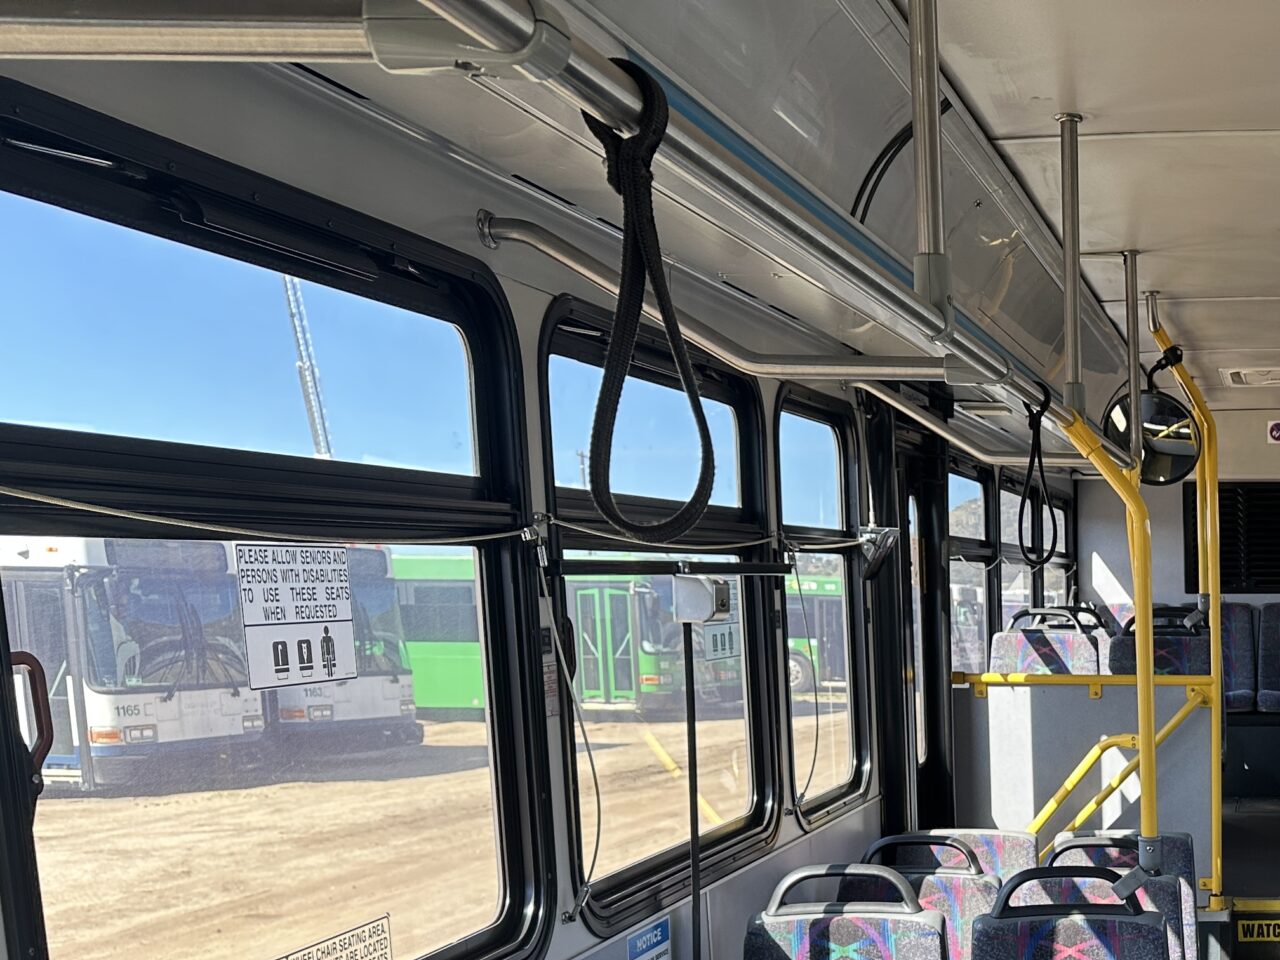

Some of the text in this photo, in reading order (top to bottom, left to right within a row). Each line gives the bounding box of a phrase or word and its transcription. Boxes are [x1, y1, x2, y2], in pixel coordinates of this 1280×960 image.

[239, 549, 346, 564] PLEASE ALLOW SENIORS AND
[241, 569, 348, 584] PERSONS WITH DISABILITIES
[242, 586, 350, 603] TO USE THESE SEATS
[263, 604, 337, 621] WHEN REQUESTED
[114, 704, 140, 717] 1165
[338, 930, 367, 952] SEATING
[636, 927, 662, 952] NOTICE
[360, 937, 388, 960] LOCATED
